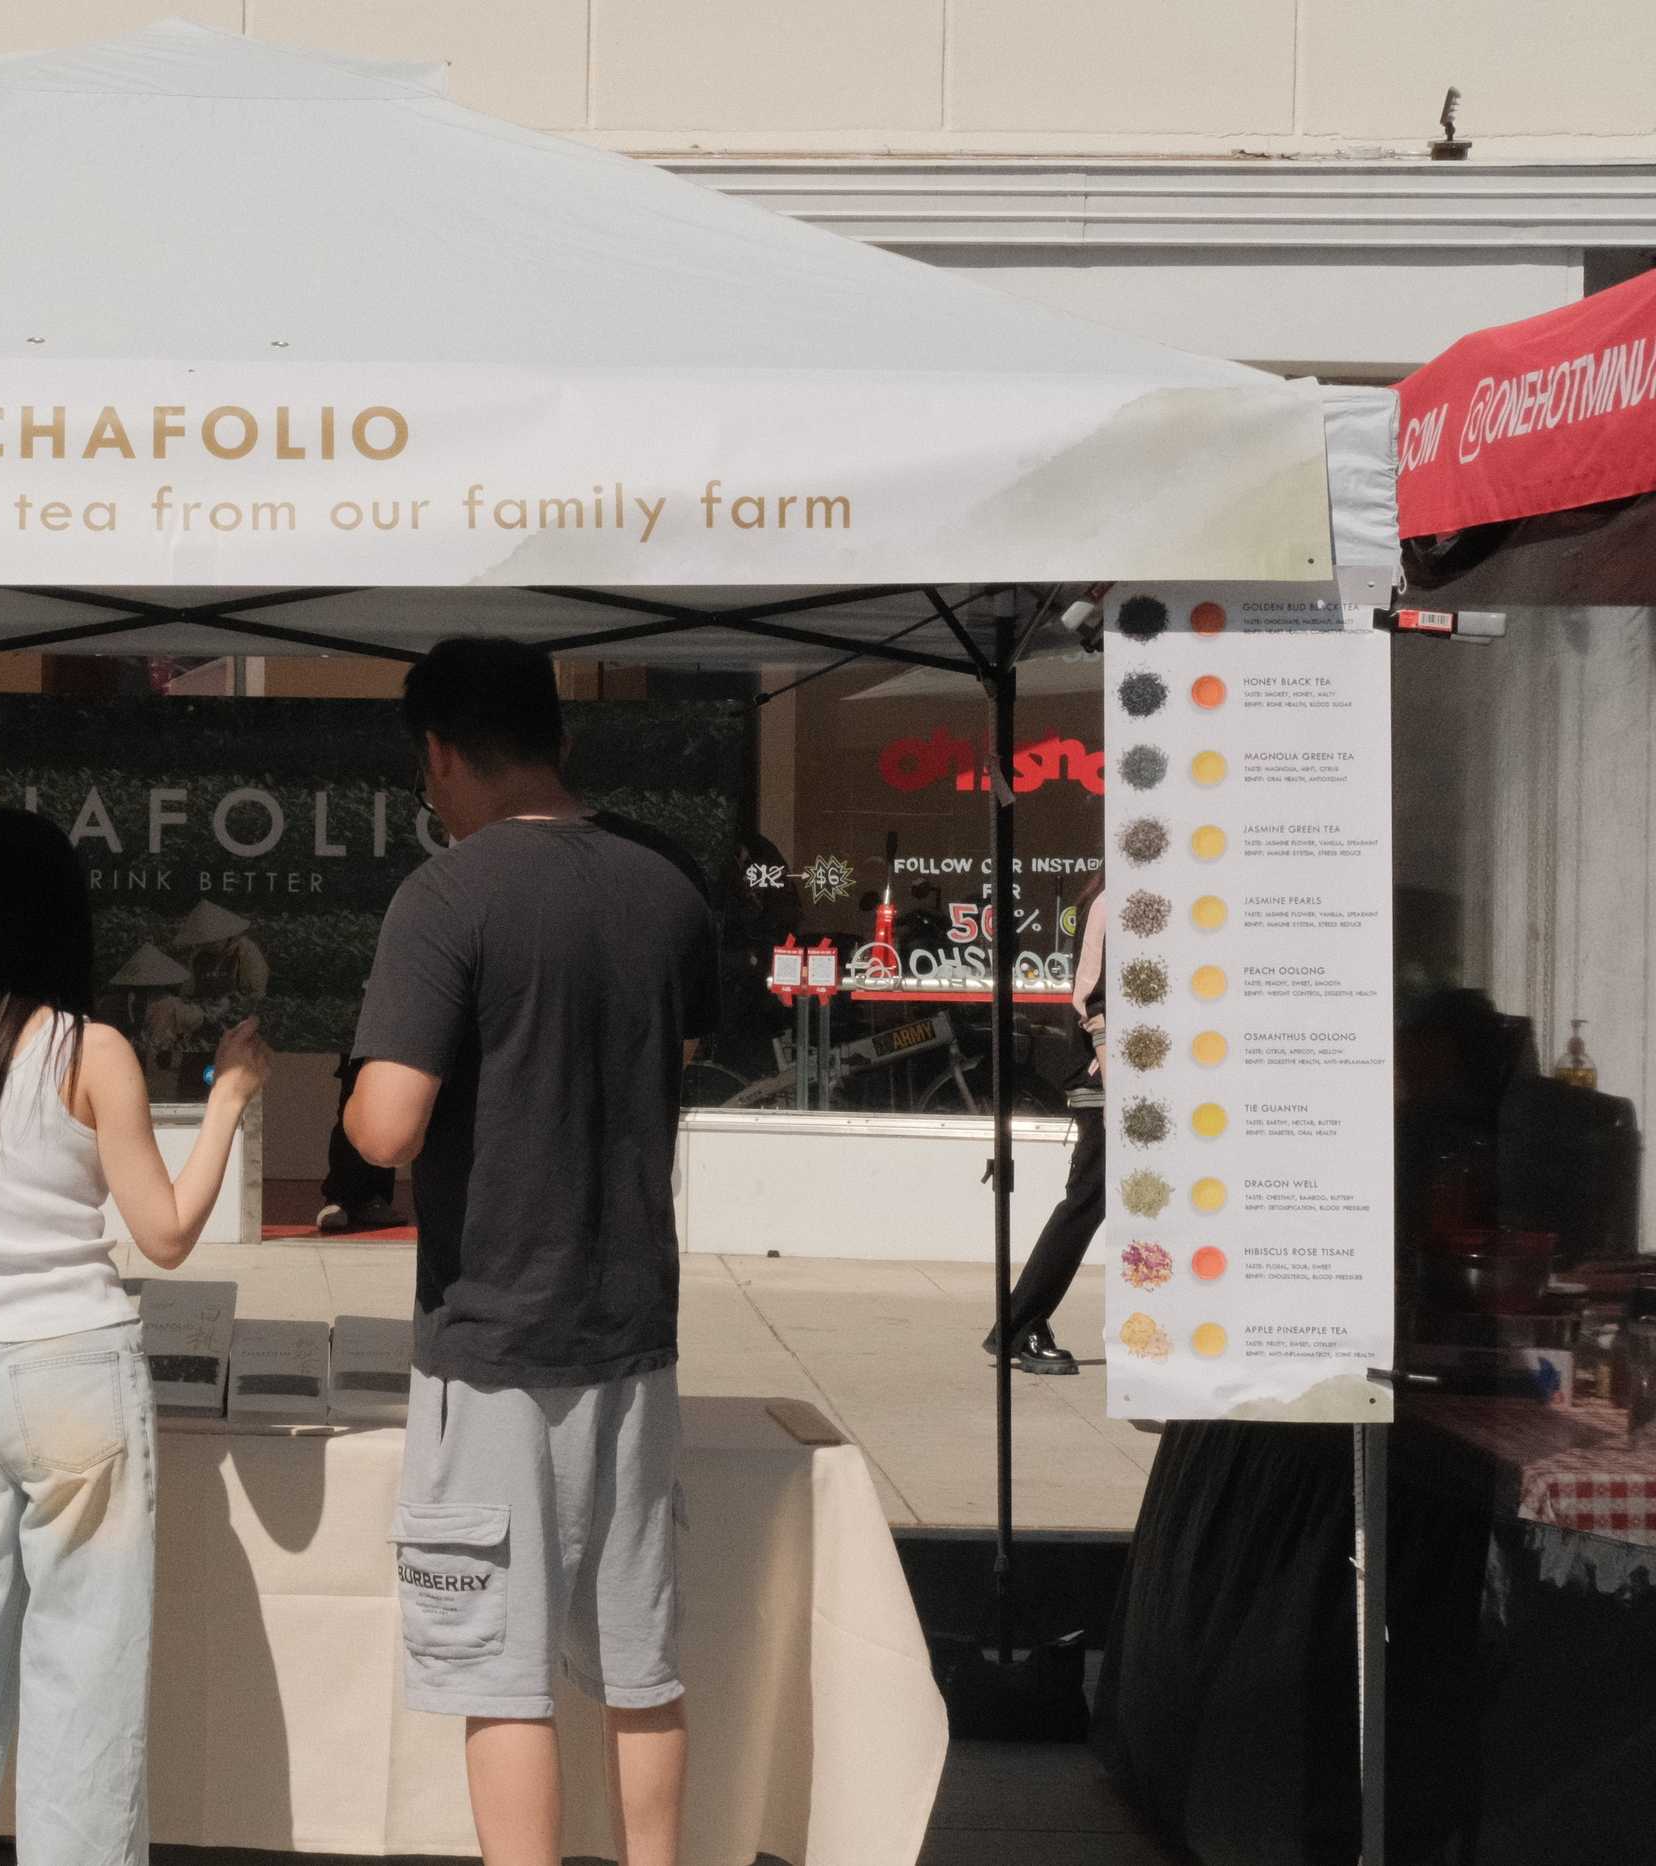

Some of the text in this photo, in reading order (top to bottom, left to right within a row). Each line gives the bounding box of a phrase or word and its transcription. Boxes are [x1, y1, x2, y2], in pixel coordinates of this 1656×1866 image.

[15, 493, 117, 532] tea
[152, 486, 296, 532] from
[330, 499, 430, 531] our
[463, 482, 666, 543] family
[701, 480, 852, 529] farm
[1243, 602, 1283, 612] GOLDEN
[1340, 602, 1359, 612] TEA
[1244, 677, 1330, 687] HONEY BLACK TEA
[1245, 752, 1354, 761] MAGNOLIA GREEN TEA
[1244, 825, 1340, 834] JASMINE GREEN TEA
[894, 858, 973, 873] FOLLOW
[90, 870, 324, 893] RINK BETTER
[816, 866, 840, 888] $6
[982, 883, 1021, 899] FR
[1245, 896, 1321, 905] JASMINE PEARLS
[1244, 966, 1325, 976] PEACH OOLONG
[893, 1019, 937, 1050] ARMY
[1244, 1032, 1356, 1042] OSMANTHUS OOLONG
[1245, 1104, 1307, 1113] TIE GUANYIN
[1245, 1180, 1317, 1189] DRAGON WELL
[1245, 1248, 1354, 1257] HIBISCUS ROSE TISANE
[1245, 1325, 1347, 1335] APPLE PINEAPPLE TEA
[397, 1565, 492, 1592] BURBERRY
